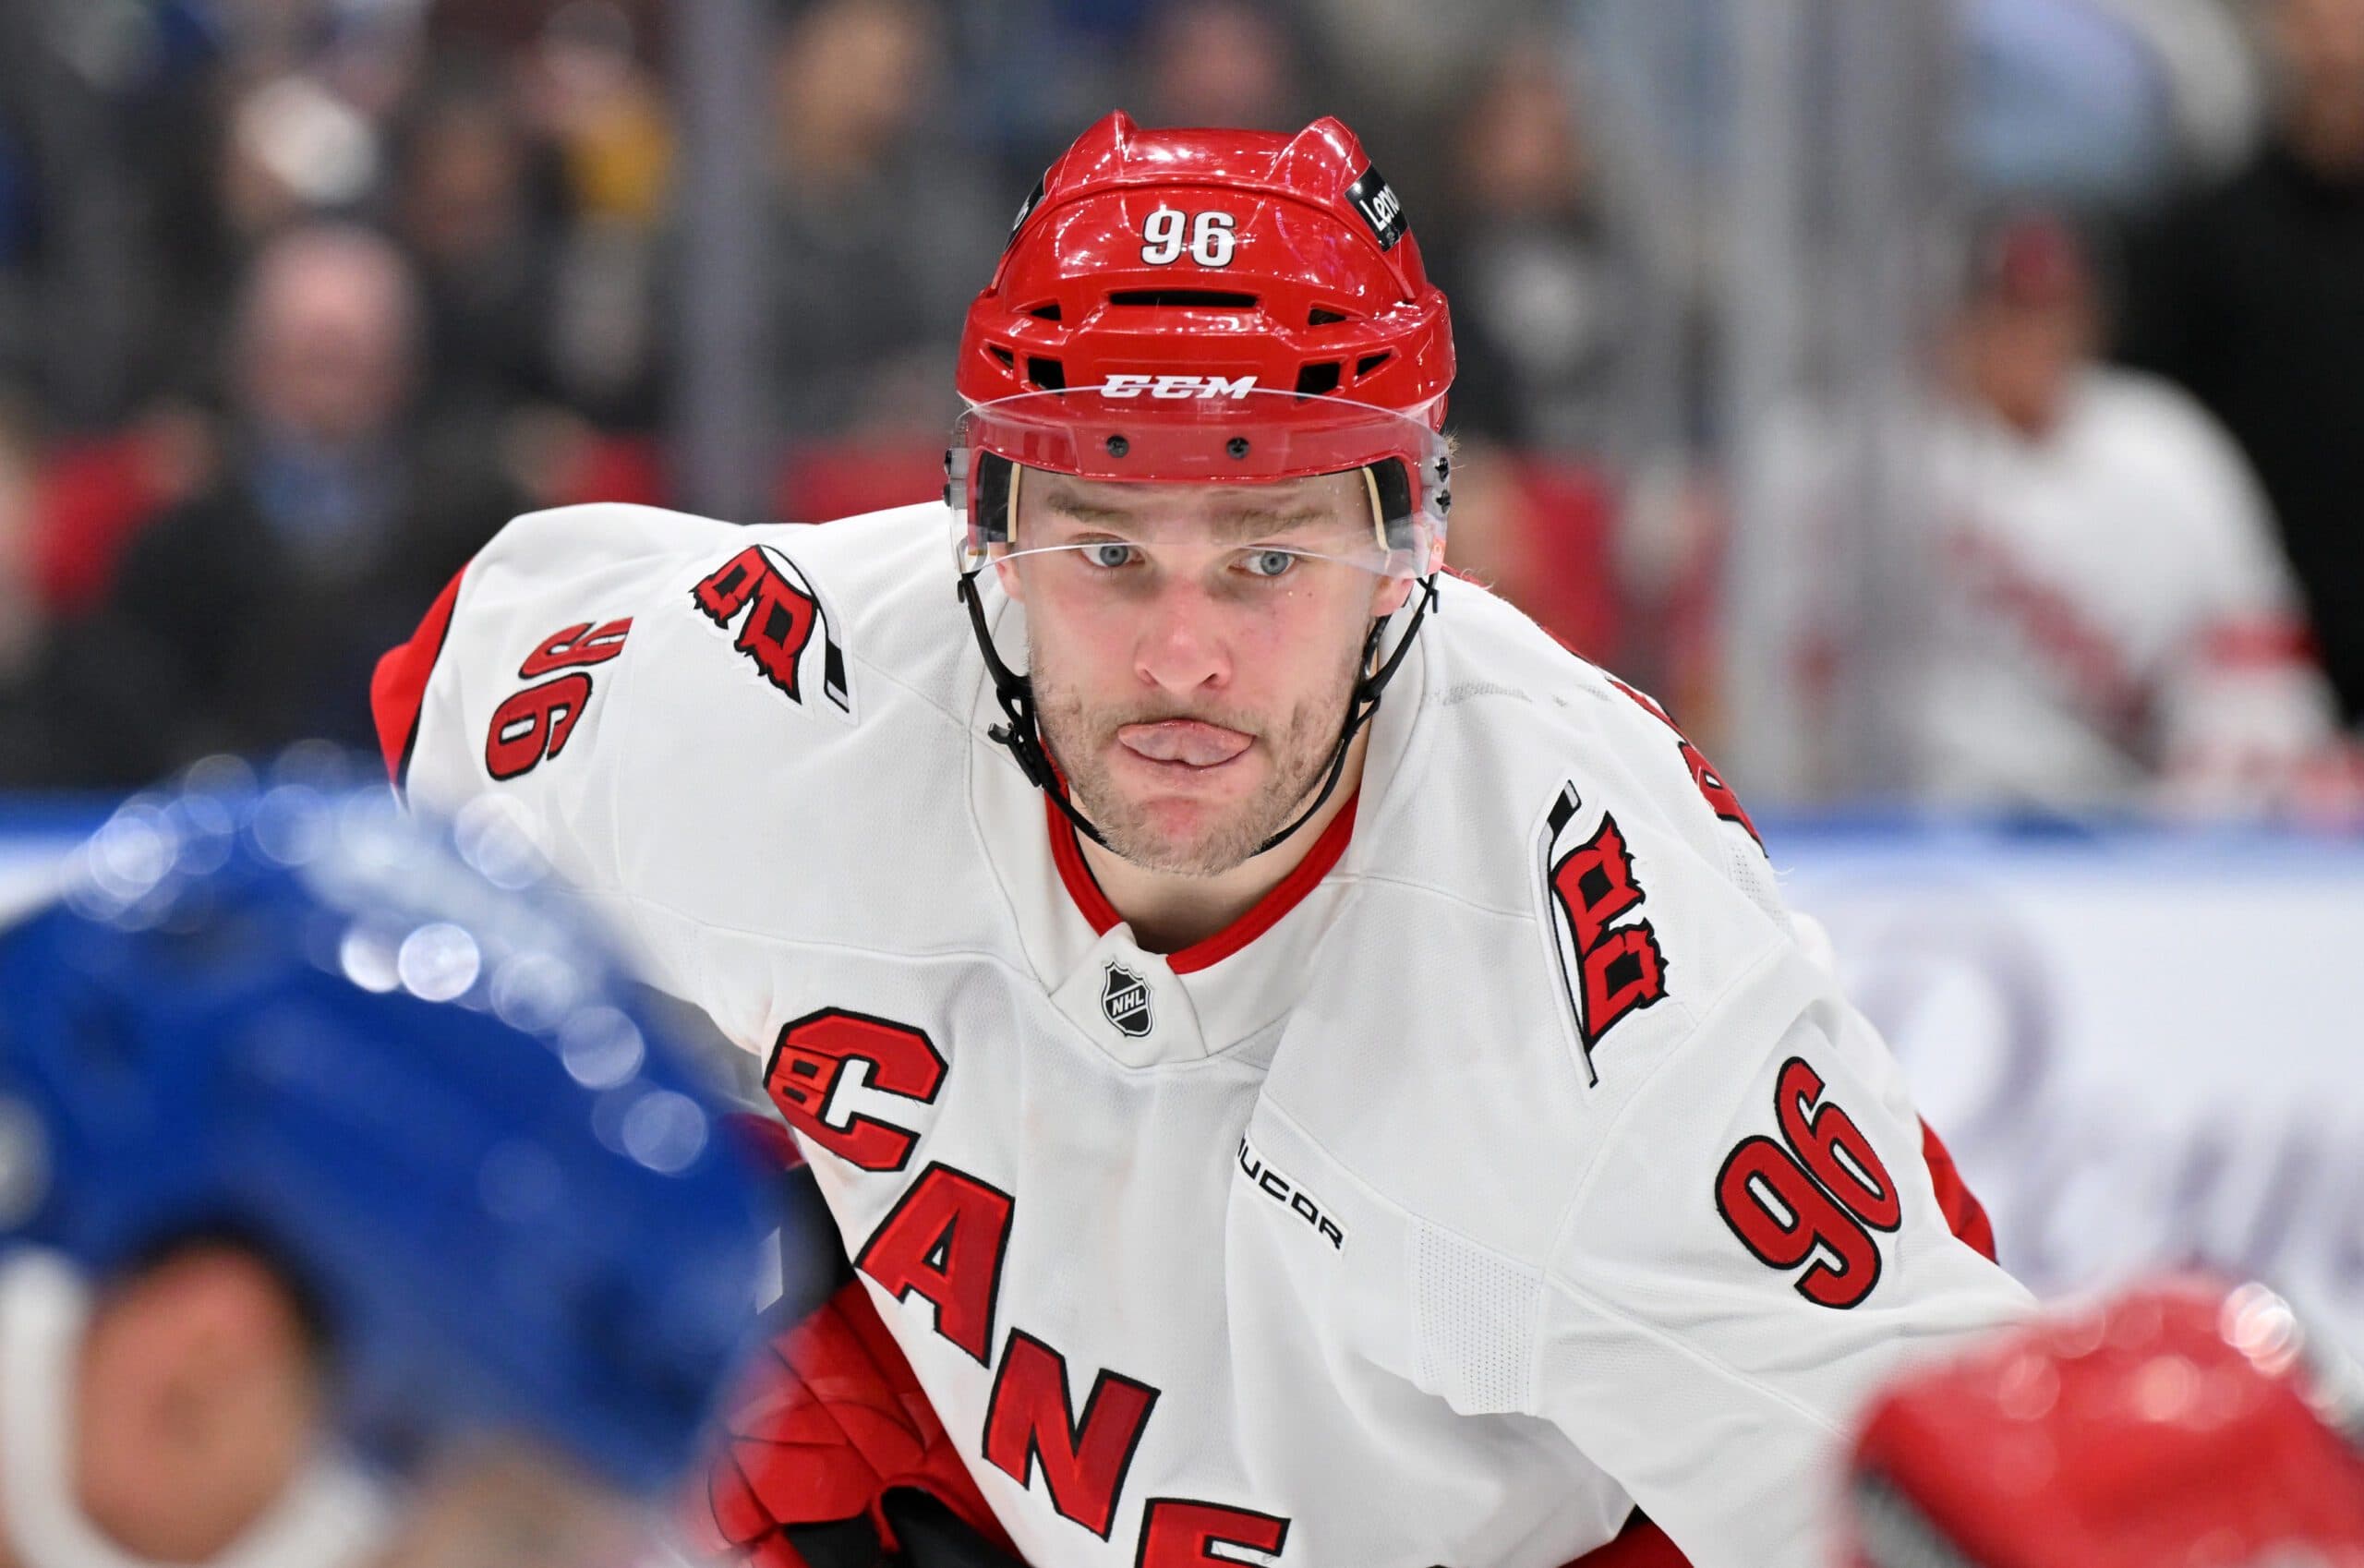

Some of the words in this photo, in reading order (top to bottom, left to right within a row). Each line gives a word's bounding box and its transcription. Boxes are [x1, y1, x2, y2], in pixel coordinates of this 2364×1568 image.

[1140, 209, 1236, 268] 96
[1101, 374, 1259, 400] CCM
[486, 616, 634, 781] 96
[1112, 989, 1145, 1017] NHL
[1714, 1055, 1902, 1310] 96
